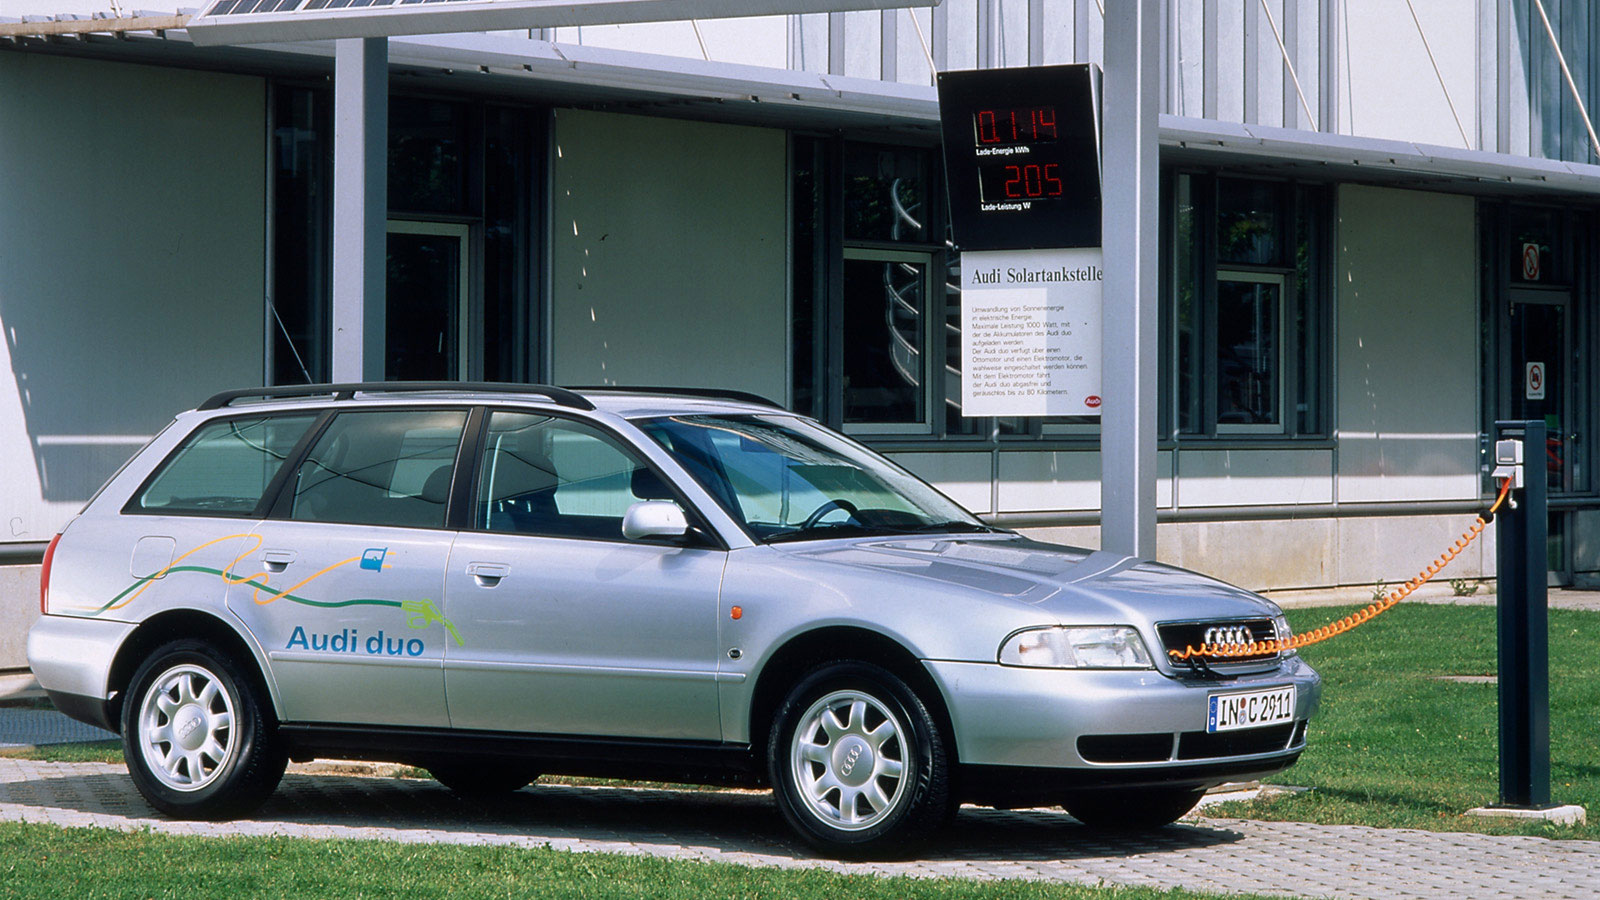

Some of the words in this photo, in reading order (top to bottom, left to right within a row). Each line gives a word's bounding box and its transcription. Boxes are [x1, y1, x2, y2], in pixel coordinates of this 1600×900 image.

[976, 147, 1014, 156] Lade-Energie
[1005, 164, 1062, 197] 205
[981, 203, 1022, 211] Lade-Leistung
[972, 268, 1001, 284] Audi
[1007, 265, 1103, 283] Solartankstelle
[1004, 364, 1041, 372] eingeschaltet
[998, 372, 1034, 380] Elektromotor
[285, 626, 357, 653] Audi
[365, 630, 425, 657] duo
[1219, 698, 1239, 726] IN
[1248, 697, 1257, 723] C
[1260, 692, 1291, 722] 2911
